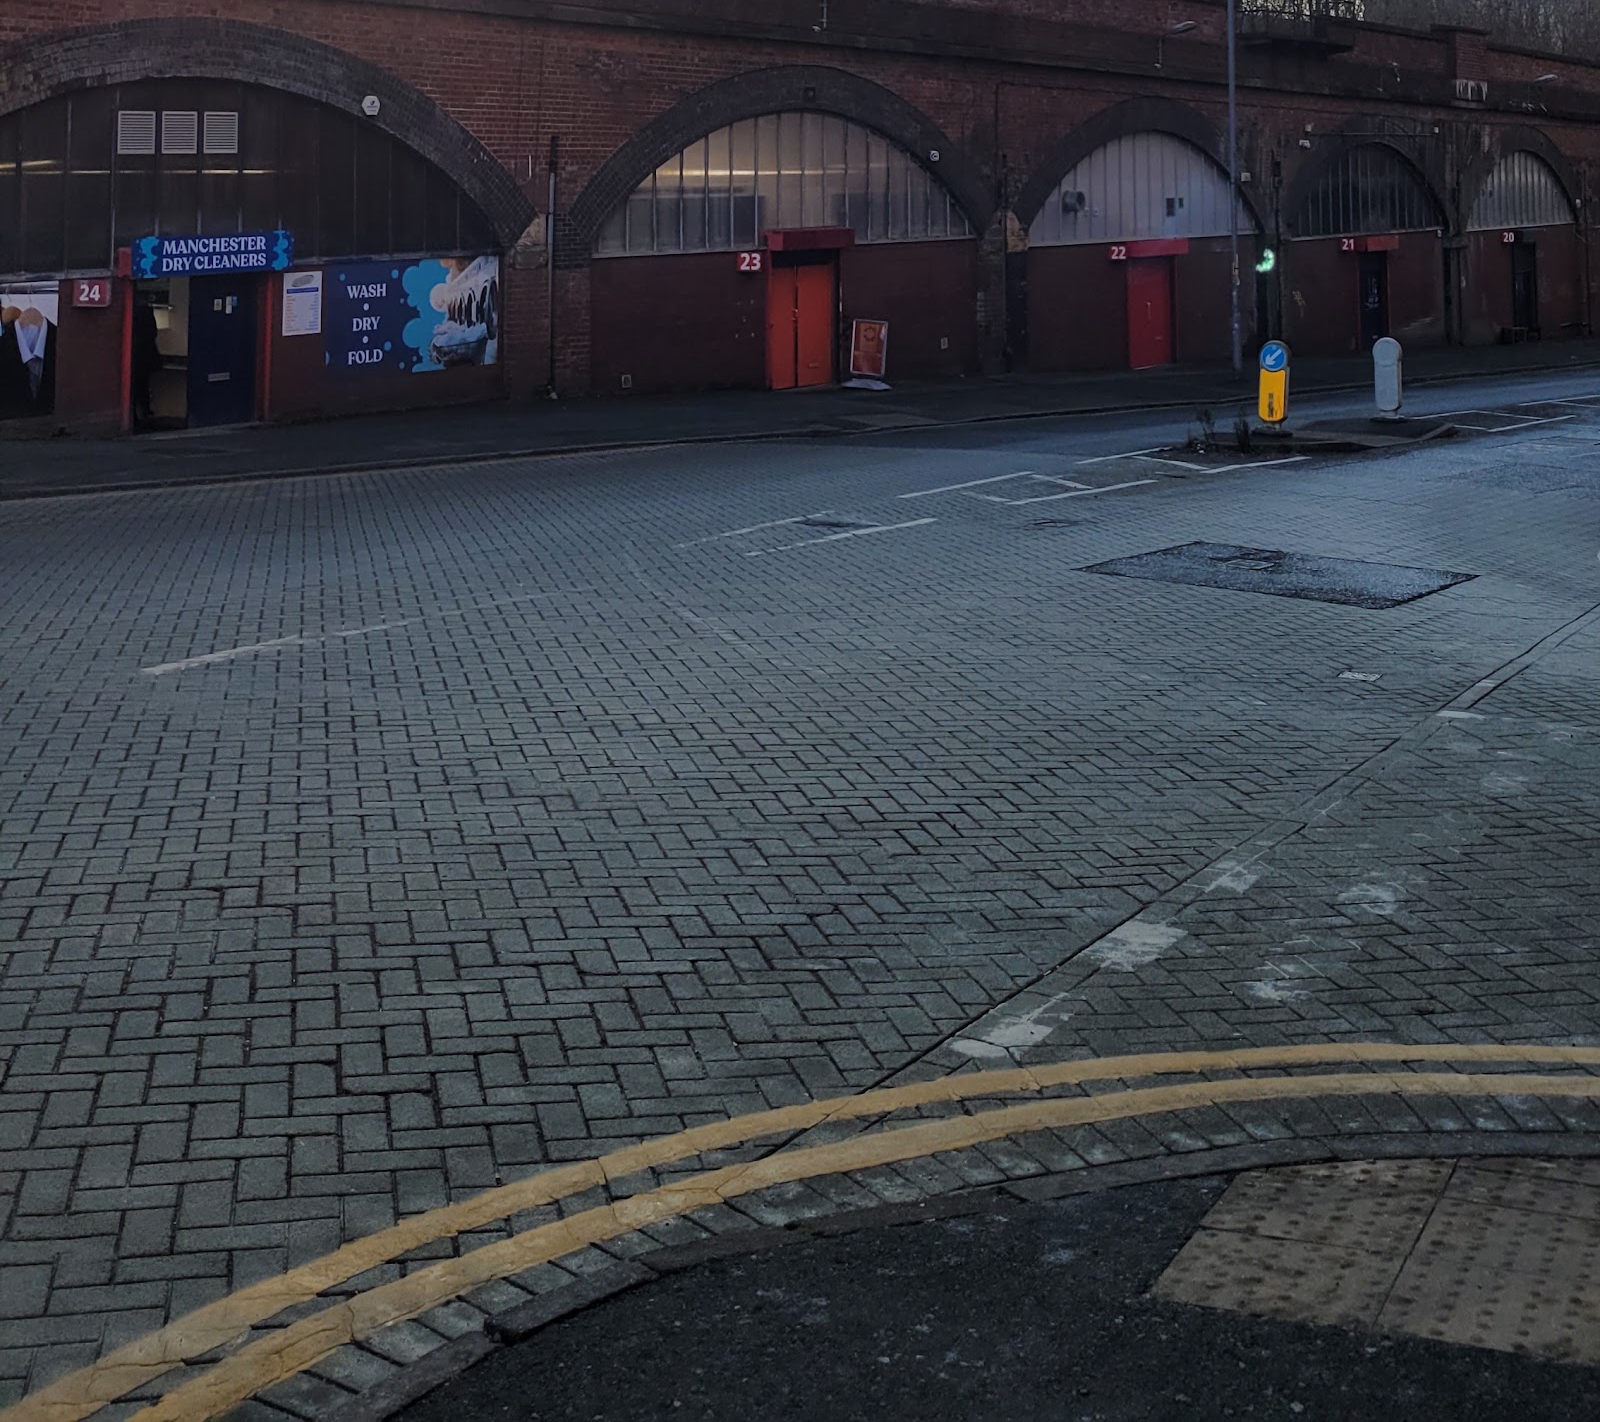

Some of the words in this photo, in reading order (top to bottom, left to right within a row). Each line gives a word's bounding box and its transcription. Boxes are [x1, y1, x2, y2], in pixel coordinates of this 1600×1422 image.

[162, 236, 267, 255] MANCHESTER
[1341, 239, 1355, 251] 21
[1503, 232, 1515, 243] 20
[1111, 246, 1127, 260] 22
[162, 256, 193, 272] DRY
[194, 253, 267, 269] CLEANERS
[740, 253, 762, 271] 23
[79, 284, 101, 302] 24
[346, 283, 387, 299] WASH
[352, 316, 381, 332] DRY
[347, 349, 384, 365] FOLD
